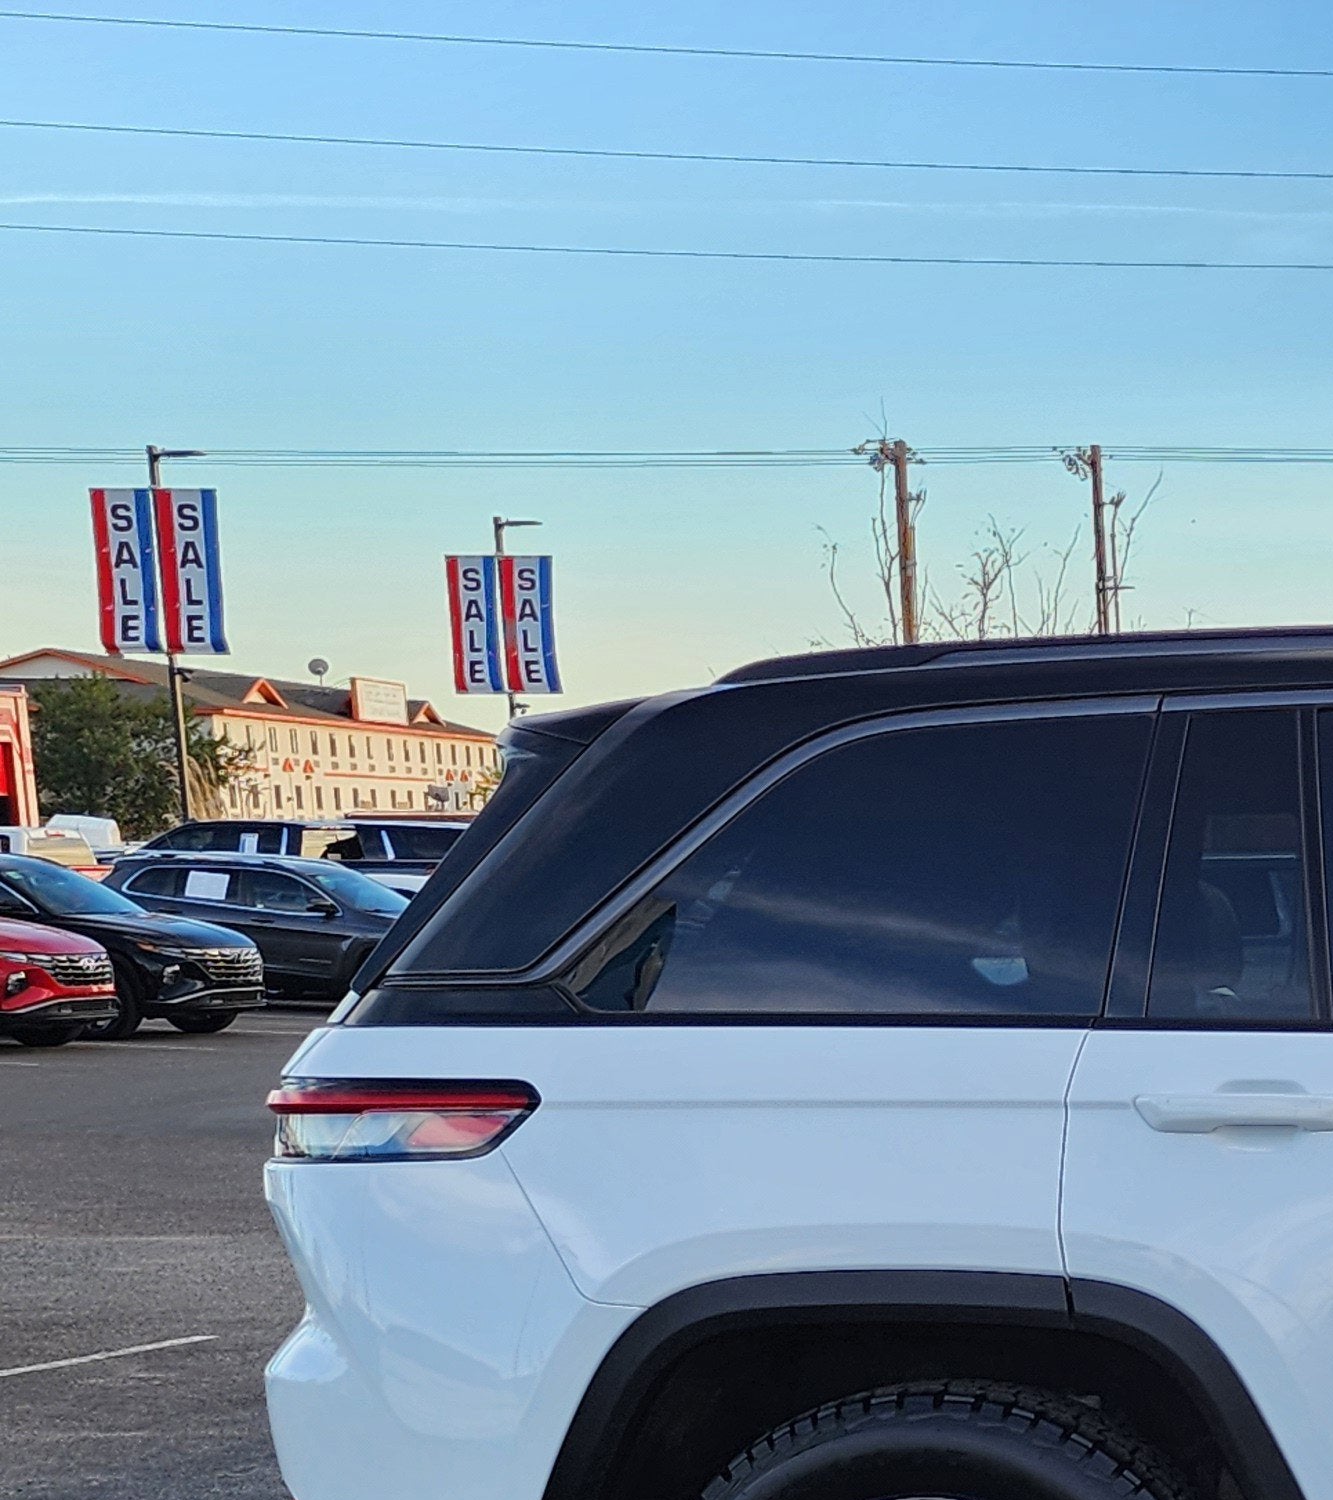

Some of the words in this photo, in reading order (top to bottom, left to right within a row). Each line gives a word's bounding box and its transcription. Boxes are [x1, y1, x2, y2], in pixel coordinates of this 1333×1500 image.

[110, 503, 140, 642] SALE
[177, 503, 206, 643] SALE
[462, 567, 486, 683] SALE
[517, 567, 543, 683] SALE
